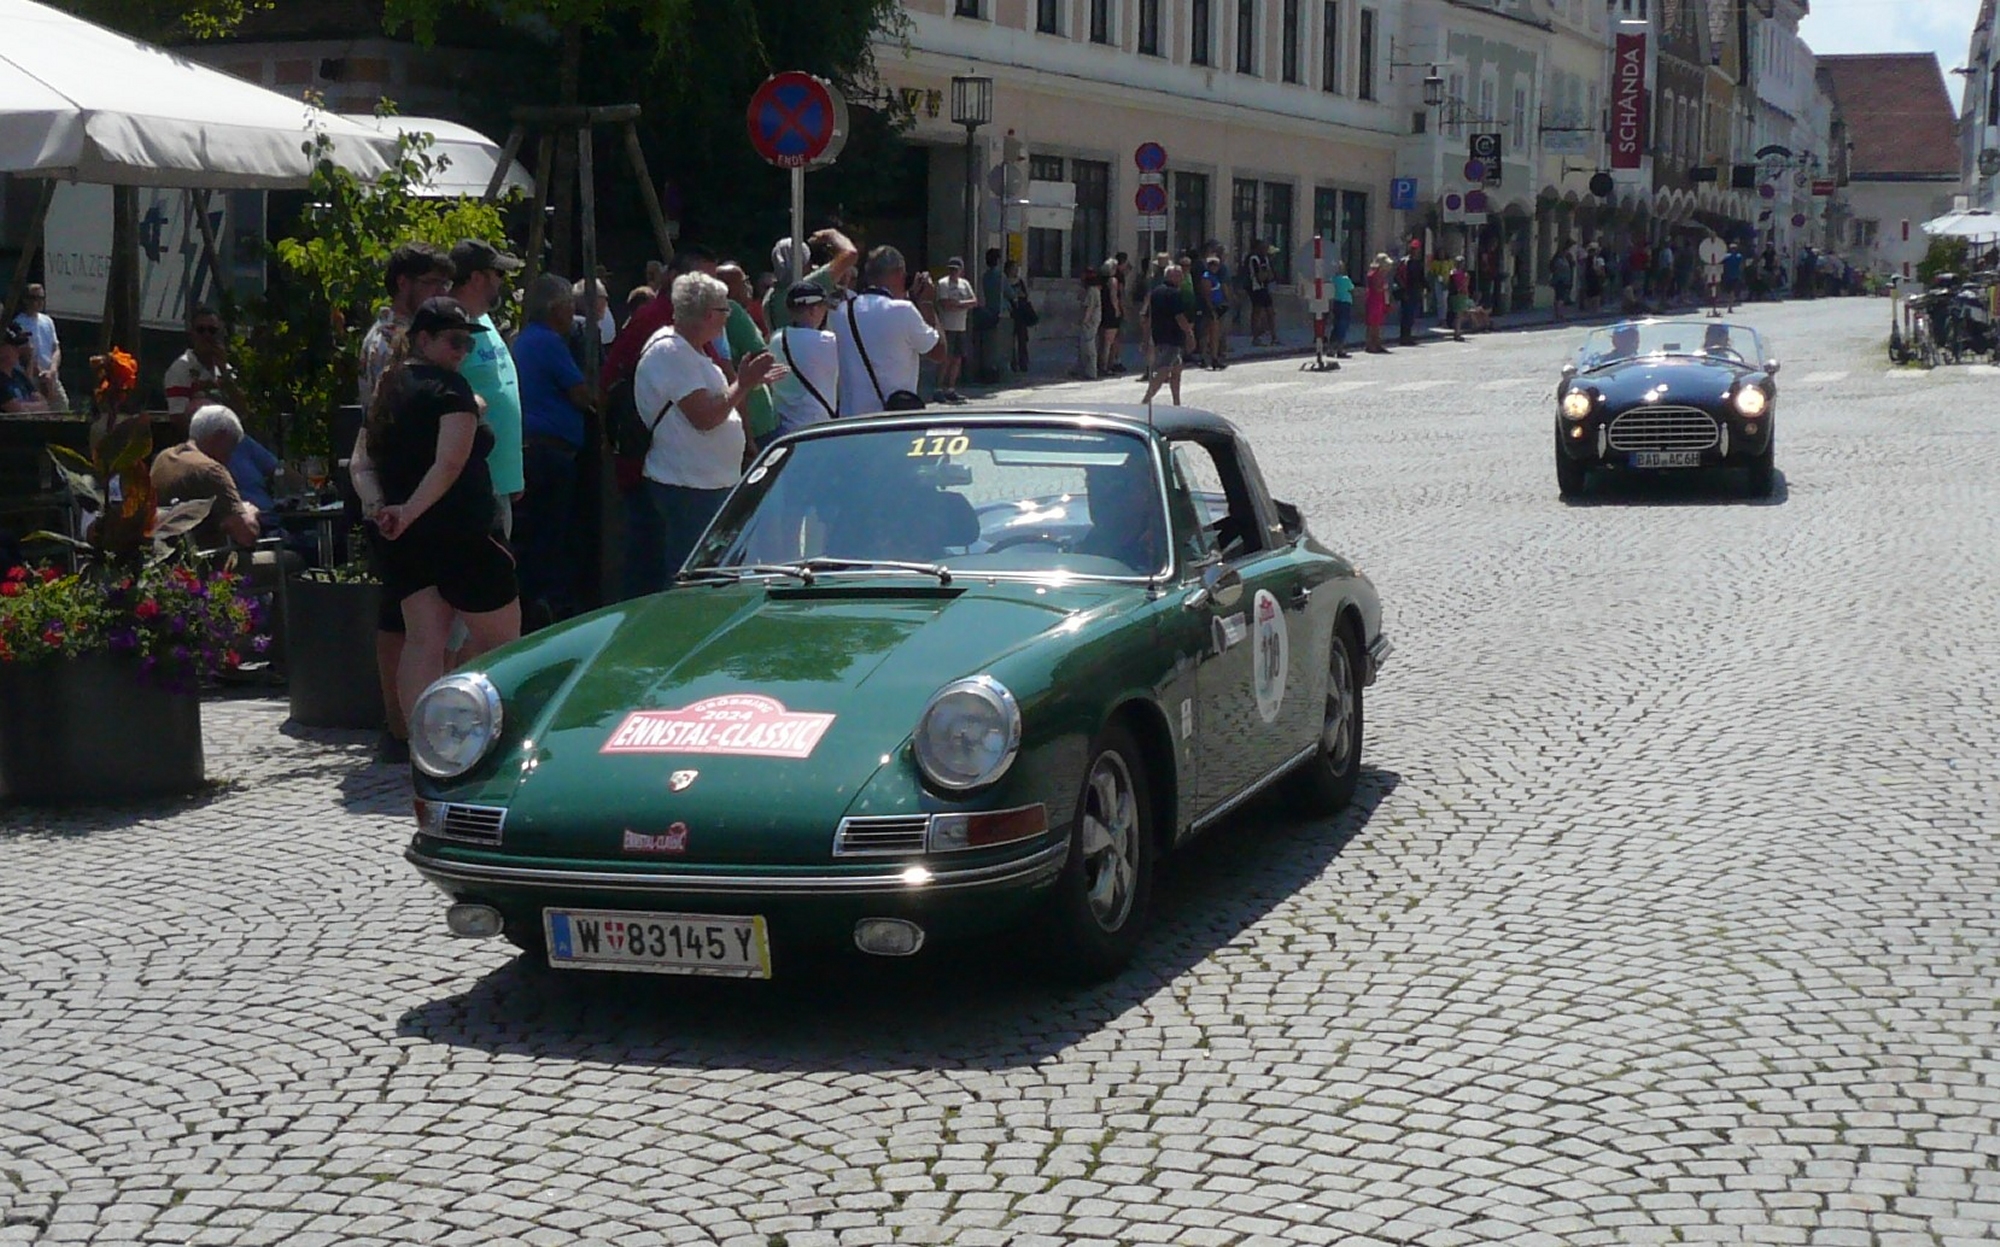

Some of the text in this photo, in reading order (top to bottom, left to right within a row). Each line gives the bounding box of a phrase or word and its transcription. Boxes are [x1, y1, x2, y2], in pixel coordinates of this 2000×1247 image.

[1618, 48, 1640, 153] SCHANDA
[777, 154, 805, 166] ENDE
[1397, 180, 1411, 200] P
[906, 435, 970, 457] 110
[1637, 453, 1660, 466] BAD
[700, 710, 754, 721] 2024
[614, 715, 822, 749] ENNSTAL-CLASSIC
[577, 919, 600, 954] W
